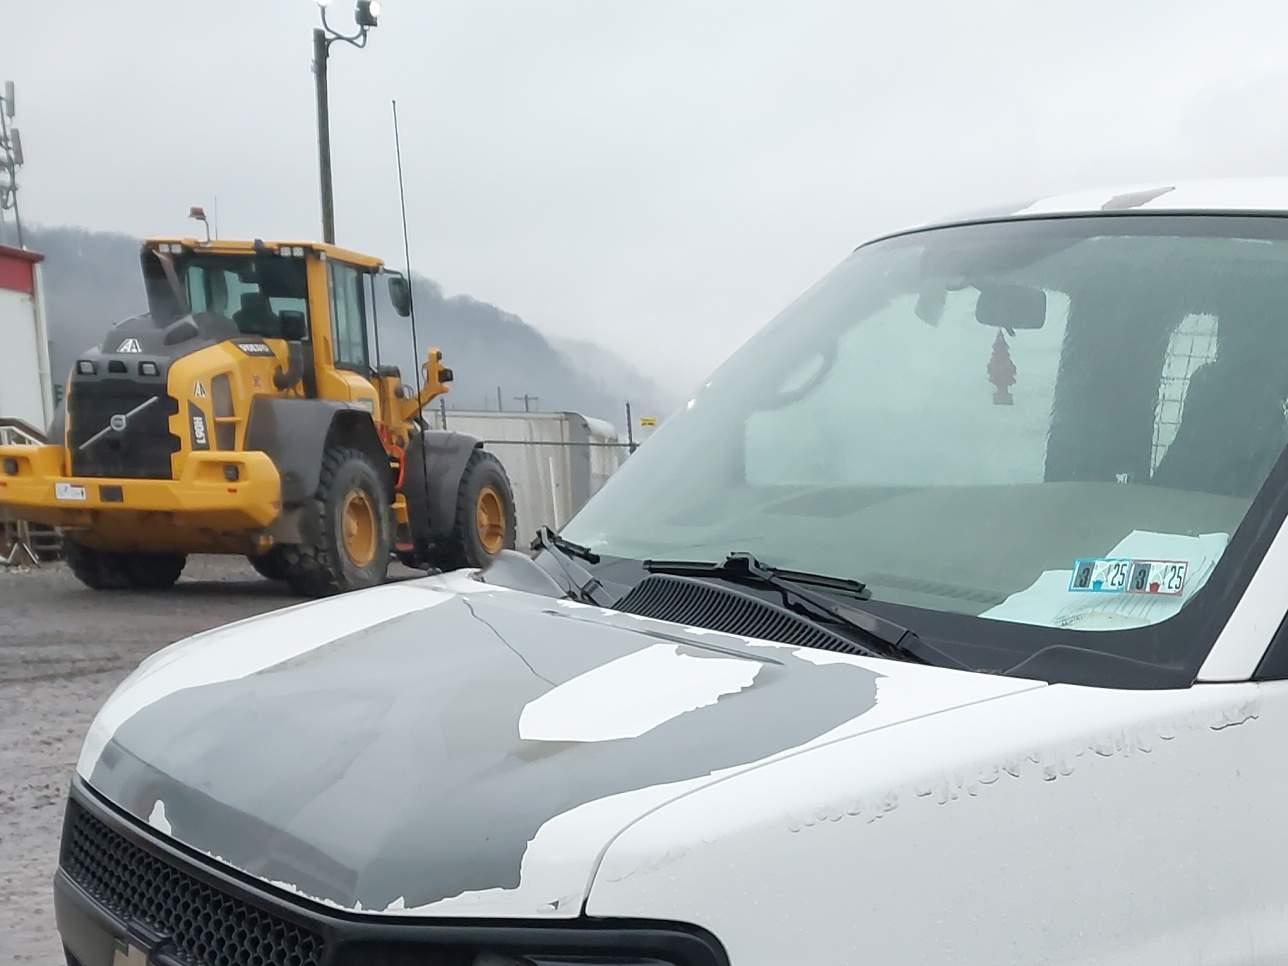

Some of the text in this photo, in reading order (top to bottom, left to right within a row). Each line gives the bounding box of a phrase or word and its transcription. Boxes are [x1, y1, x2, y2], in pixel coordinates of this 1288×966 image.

[1079, 567, 1090, 588] 3
[1135, 565, 1184, 590] 3 25
